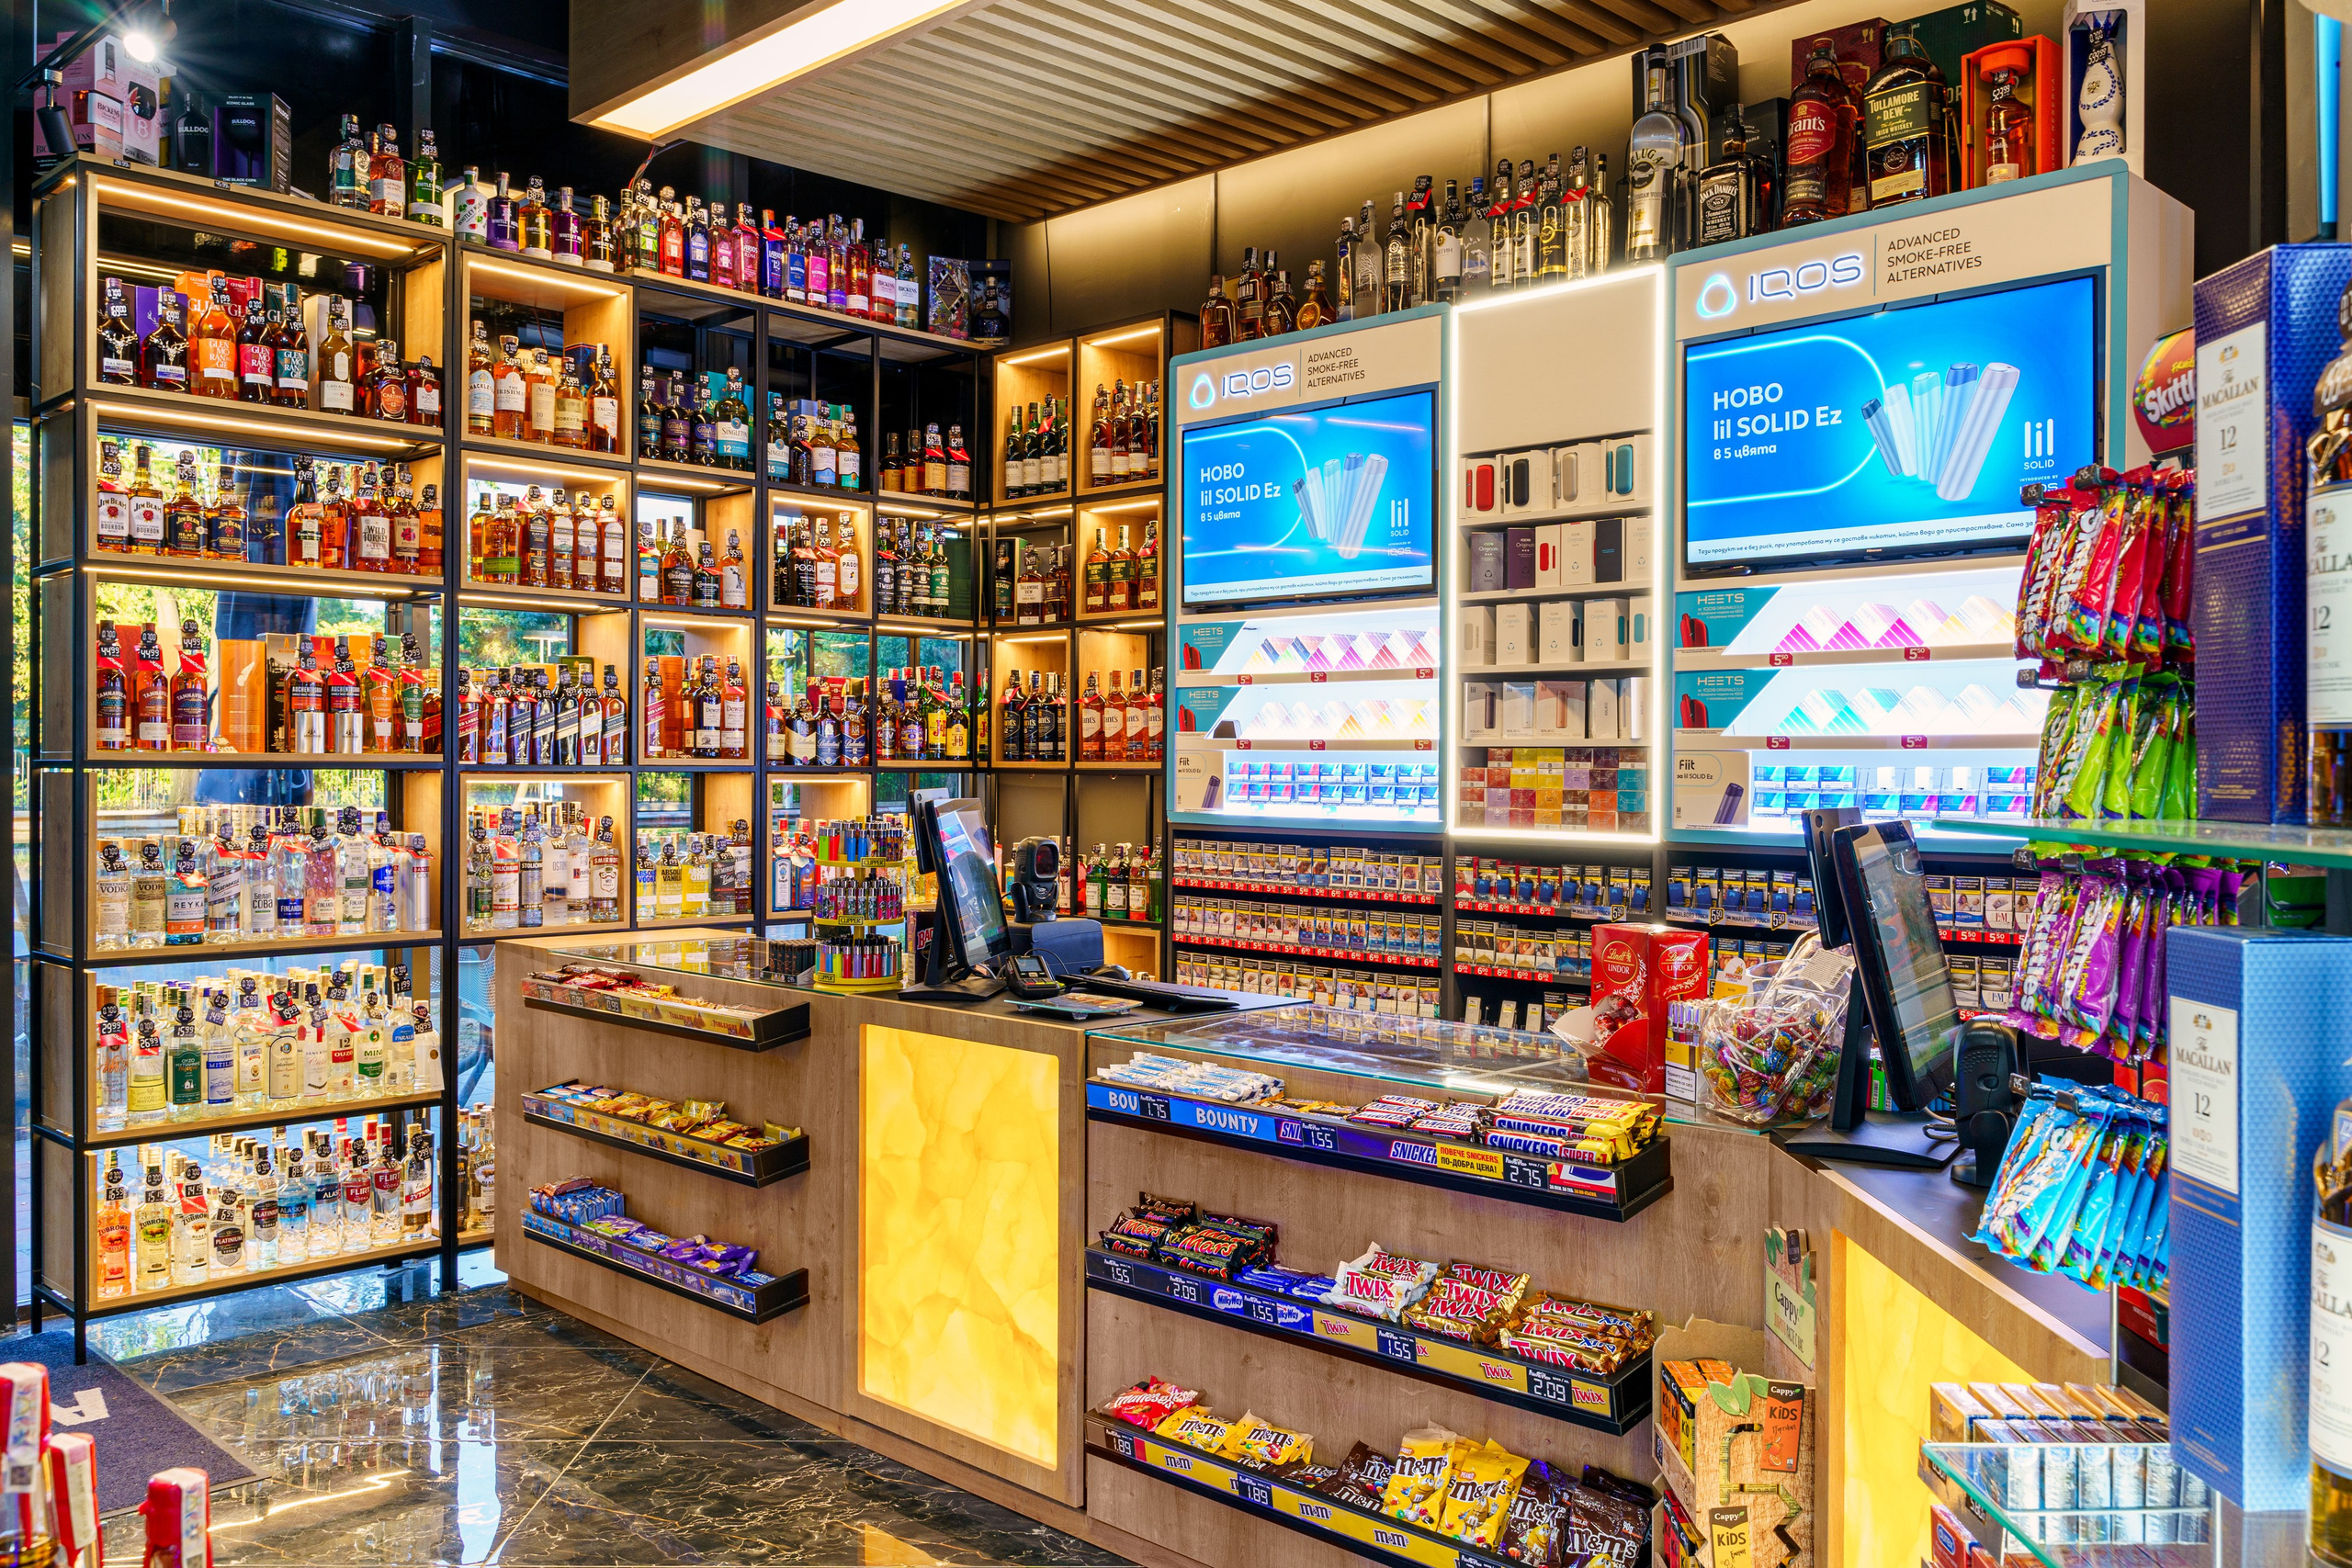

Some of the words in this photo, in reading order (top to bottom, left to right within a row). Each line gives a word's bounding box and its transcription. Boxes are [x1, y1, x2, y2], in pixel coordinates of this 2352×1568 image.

[97, 102, 120, 117] BICKENS
[1869, 91, 1919, 113] TULLAMORE
[178, 126, 209, 134] BULLDOG
[1890, 121, 1913, 133] WHISKEY
[1701, 186, 1715, 203] JACK
[1714, 185, 1738, 196] DANIEL'S
[1705, 209, 1732, 218] Tennessee
[1706, 217, 1731, 225] WHISKEY
[1887, 227, 1961, 253] ADVANCED
[1886, 242, 1972, 268] SMOKE-FREE
[1749, 254, 1862, 302] IQOS
[1886, 256, 1982, 284] ALTERNATIVES
[1308, 347, 1352, 363] ADVANCED
[1307, 358, 1359, 375] SMOKE-FREE
[1222, 365, 1292, 397] IQOS
[1307, 370, 1365, 388] ALTERNATIVES
[2219, 368, 2234, 385] The
[1713, 383, 1783, 411] НОВО
[2201, 376, 2260, 411] MACALLAN
[1713, 416, 1732, 440] lil
[1736, 412, 1809, 439] SOLID
[1815, 406, 1842, 427] Ez
[2219, 425, 2236, 451] 12
[723, 445, 731, 453] 12
[1724, 446, 1731, 459] 5
[1734, 442, 1777, 459] цвята
[2023, 458, 2054, 470] SOLID
[1201, 463, 1244, 483] НОВО
[1201, 491, 1212, 506] lil
[1215, 484, 1261, 504] SOLID
[1264, 481, 1281, 498] Ez
[98, 499, 108, 507] JIM
[110, 498, 126, 509] BEAM
[134, 502, 144, 512] JIM
[146, 502, 161, 513] BEAM
[1207, 513, 1212, 521] 5
[1214, 510, 1240, 522] цвята
[363, 532, 388, 542] TURKEY
[368, 525, 386, 536] WILD
[1786, 539, 1824, 547] употребата
[1842, 535, 1868, 544] доставя
[1946, 524, 2005, 534] пристрастяване.
[1387, 547, 1411, 556] IQOS
[1698, 593, 1744, 604] HEETS
[2022, 530, 2062, 651] Skittles
[2312, 605, 2330, 630] 12
[1698, 676, 1744, 685] HEETS
[1180, 758, 1189, 766] Fiit
[1679, 760, 1695, 771] Fiit
[863, 858, 884, 866] CLIPPER
[253, 899, 273, 908] СОВА
[840, 916, 863, 924] CLIPPER
[1607, 949, 1626, 963] Lindt
[1668, 951, 1689, 964] Lindt
[2020, 892, 2062, 1012] Skittles
[1608, 964, 1630, 975] LINDOR
[1667, 963, 1693, 973] LINDOR
[819, 973, 834, 981] CLIPPER
[338, 1037, 351, 1048] 12
[2195, 1036, 2208, 1051] The
[2176, 1047, 2233, 1076] MACALLAN
[1148, 1103, 1167, 1119] 1.75
[2195, 1092, 2211, 1117] 12
[1196, 1107, 1259, 1134] BOUNTY
[1311, 1131, 1333, 1148] 1.55
[1441, 1146, 1464, 1157] ПОВЕЧЕ
[1488, 1135, 1558, 1157] SNICKERS
[1564, 1149, 1595, 1163] SUPER
[1442, 1157, 1475, 1168] ПО-ДОБРА
[1476, 1163, 1497, 1173] ЦЕНА!
[379, 1174, 401, 1183] FLIRT
[1510, 1166, 1541, 1187] 2.75
[350, 1188, 369, 1196] FLIRT
[1146, 1212, 1166, 1222] Mars
[1118, 1220, 1164, 1238] Mars
[216, 1235, 243, 1246] PLATINIUM
[1179, 1235, 1238, 1257] Mars
[1111, 1266, 1130, 1282] 1.55
[1453, 1264, 1516, 1293] Twix
[714, 1287, 731, 1295] OREO
[1173, 1284, 1196, 1302] 2.09
[1347, 1271, 1396, 1299] Twix
[1427, 1296, 1491, 1320] Twix
[1775, 1282, 1798, 1325] Cappy
[1252, 1303, 1273, 1322] 1.55
[1322, 1319, 1350, 1335] Twix
[1386, 1339, 1410, 1360] 1.55
[2312, 1342, 2330, 1367] 12
[1481, 1362, 1514, 1380] Twix
[1533, 1380, 1566, 1401] 2.09
[1572, 1387, 1605, 1404] Twix
[1770, 1385, 1796, 1396] Cappy
[1179, 1419, 1227, 1438] m&m's
[1246, 1427, 1294, 1447] m&m's
[1113, 1438, 1131, 1455] 1.89
[1164, 1454, 1193, 1471] m&m's
[1247, 1487, 1269, 1505] 1.89
[1449, 1479, 1507, 1502] m&m's
[1299, 1502, 1332, 1519] m&m's
[1714, 1512, 1740, 1521] Cappy
[1374, 1529, 1409, 1548] m&m's
[1568, 1527, 1637, 1559] m&m's
